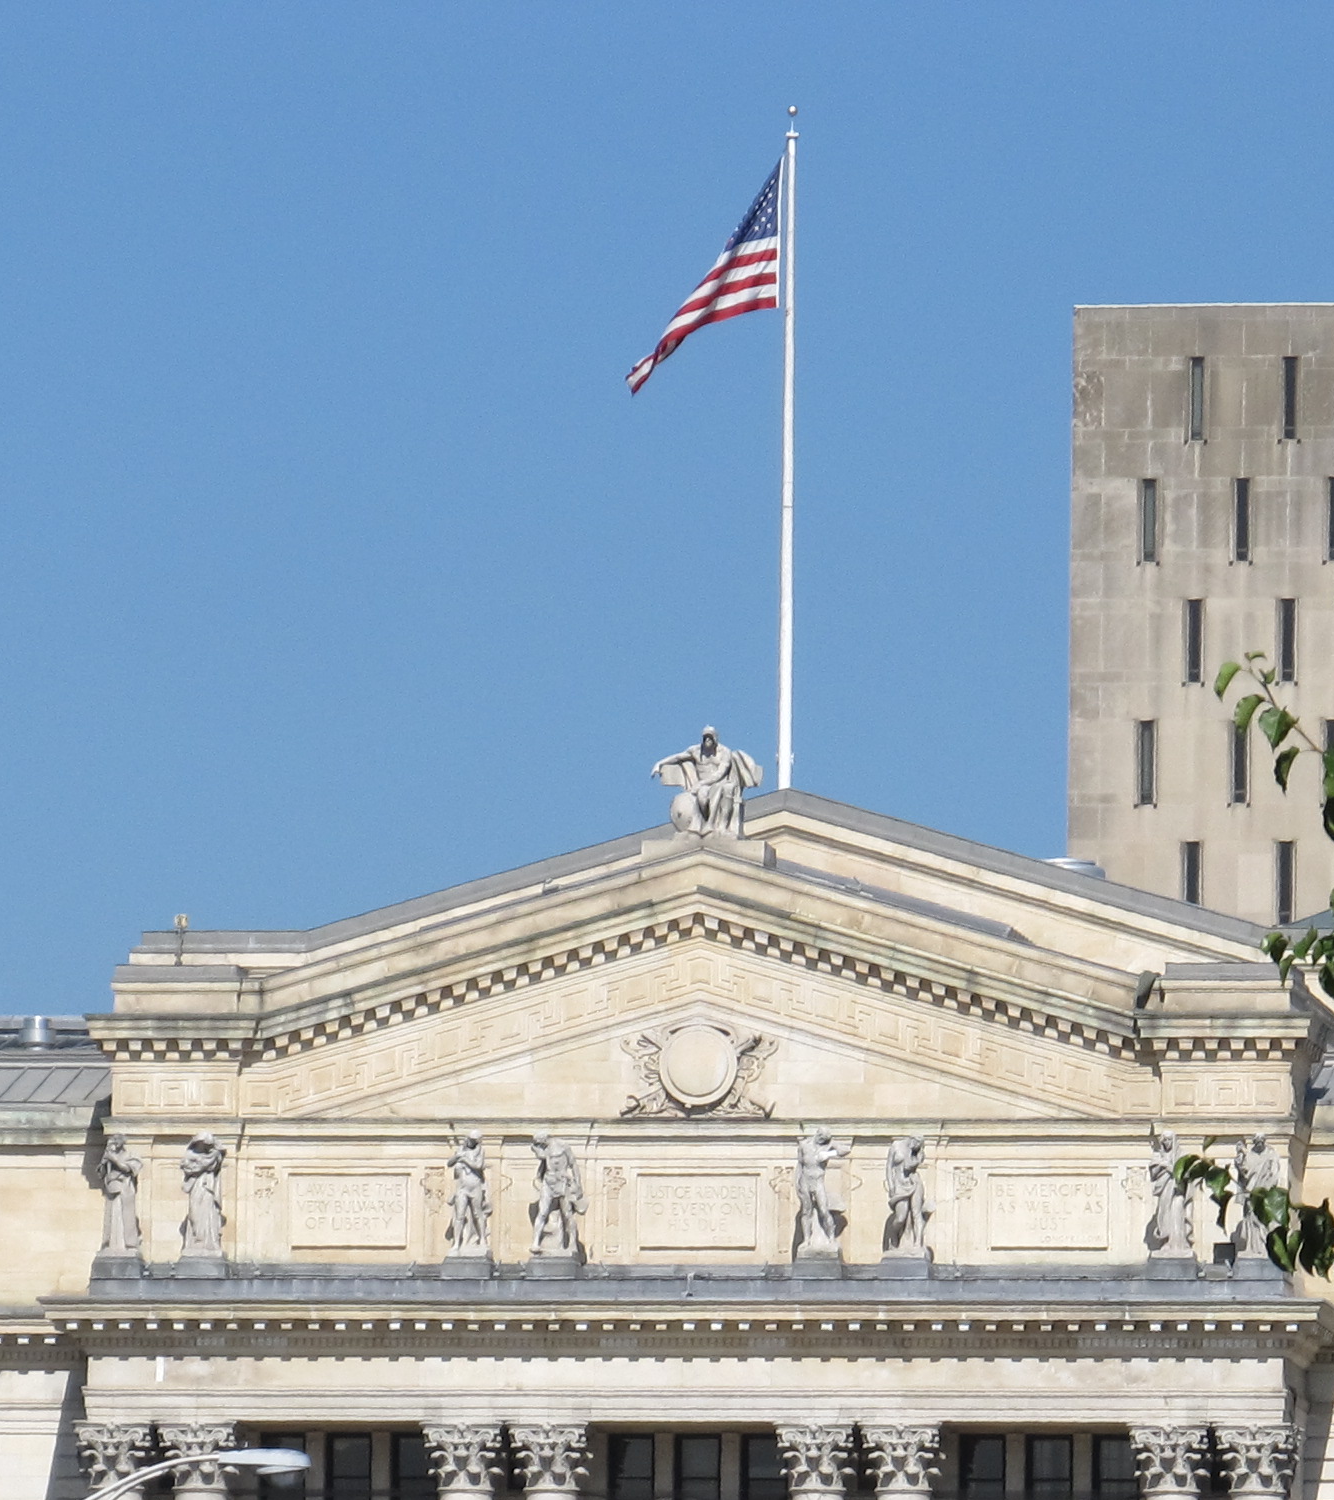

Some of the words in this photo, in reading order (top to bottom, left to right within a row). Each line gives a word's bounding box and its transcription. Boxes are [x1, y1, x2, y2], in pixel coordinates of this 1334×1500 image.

[296, 1183, 335, 1198] LAWS
[340, 1183, 371, 1198] ARE
[375, 1183, 403, 1198] THE
[643, 1185, 692, 1200] JUSTICE
[695, 1185, 756, 1200] RENDERS
[994, 1183, 1015, 1198] BE
[1023, 1183, 1104, 1198] MERCIFUL
[296, 1200, 331, 1214] VERY
[334, 1200, 404, 1214] BULWARKS
[643, 1202, 665, 1216] TO
[671, 1202, 717, 1216] EVERY
[720, 1202, 754, 1216] ONE
[996, 1201, 1017, 1214] AS
[1024, 1201, 1073, 1214] WELL
[1083, 1200, 1104, 1214] AS
[305, 1216, 327, 1230] OF
[331, 1216, 393, 1231] LIBERTY
[668, 1218, 691, 1232] HIS
[698, 1218, 728, 1232] DUE
[1029, 1217, 1068, 1231] JUST
